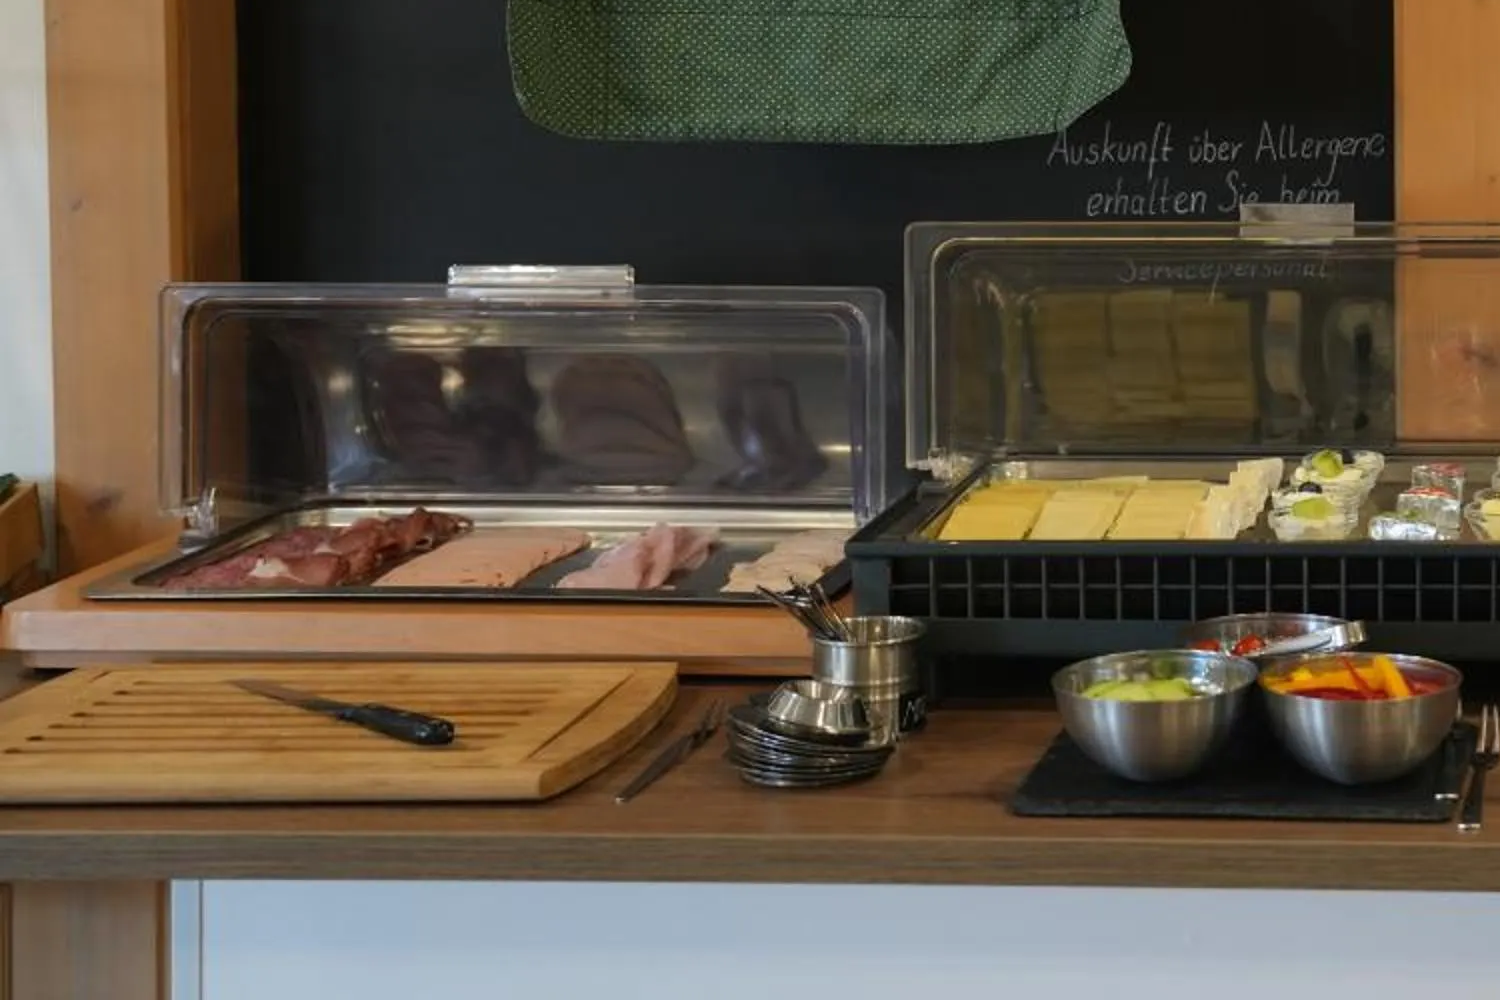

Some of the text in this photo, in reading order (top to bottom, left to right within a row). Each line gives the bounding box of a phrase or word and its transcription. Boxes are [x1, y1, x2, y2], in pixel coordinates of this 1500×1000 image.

[1047, 120, 1385, 187] Auskunft über Allergene
[1086, 177, 1208, 217] erhalten
